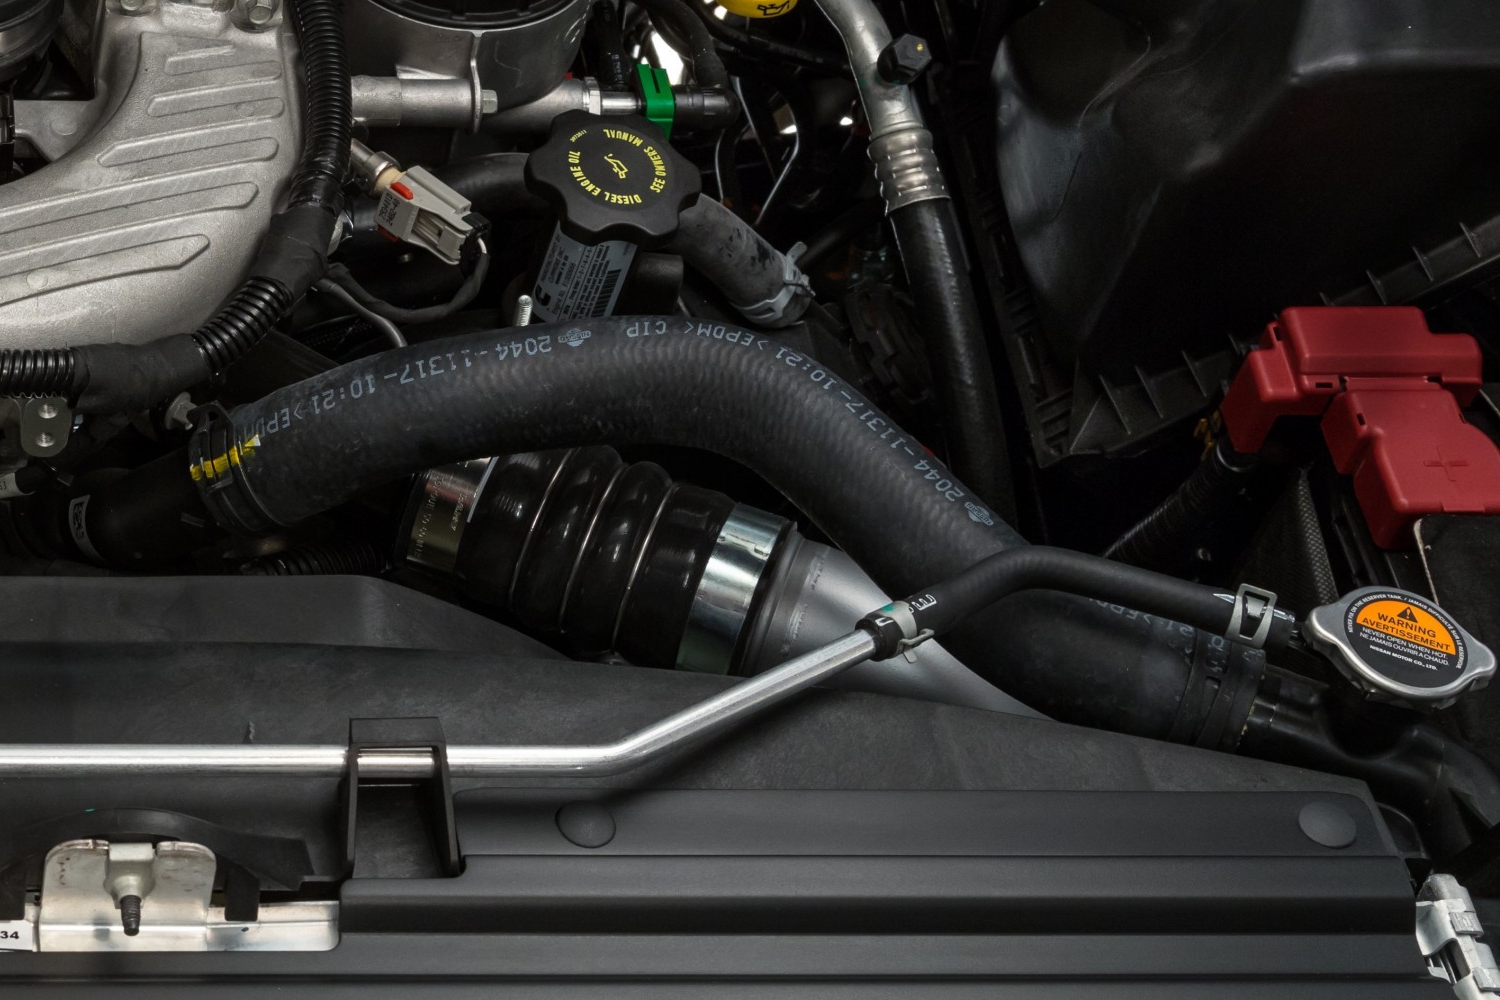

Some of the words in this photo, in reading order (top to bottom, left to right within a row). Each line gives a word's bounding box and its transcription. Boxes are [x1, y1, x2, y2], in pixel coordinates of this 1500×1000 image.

[603, 128, 644, 147] MANUAL
[568, 150, 580, 164] OIL
[643, 146, 667, 177] OWNERS
[569, 165, 602, 196] ENGINE
[650, 177, 666, 193] SEE
[604, 191, 642, 205] DIESEL
[625, 321, 667, 338] CIP
[1362, 617, 1451, 651] AVERTISSEMENT
[1377, 612, 1437, 638] WARNING
[1359, 632, 1369, 640] NE
[1368, 634, 1393, 648] JAMAIS
[1393, 642, 1418, 657] OUVRIR
[1362, 627, 1386, 639] NEVER
[1386, 634, 1407, 646] OPEN
[1408, 641, 1431, 654] WHEN
[1431, 649, 1448, 660] HOT.
[1369, 644, 1391, 655] NISSAN
[1392, 652, 1413, 664] MOTOR
